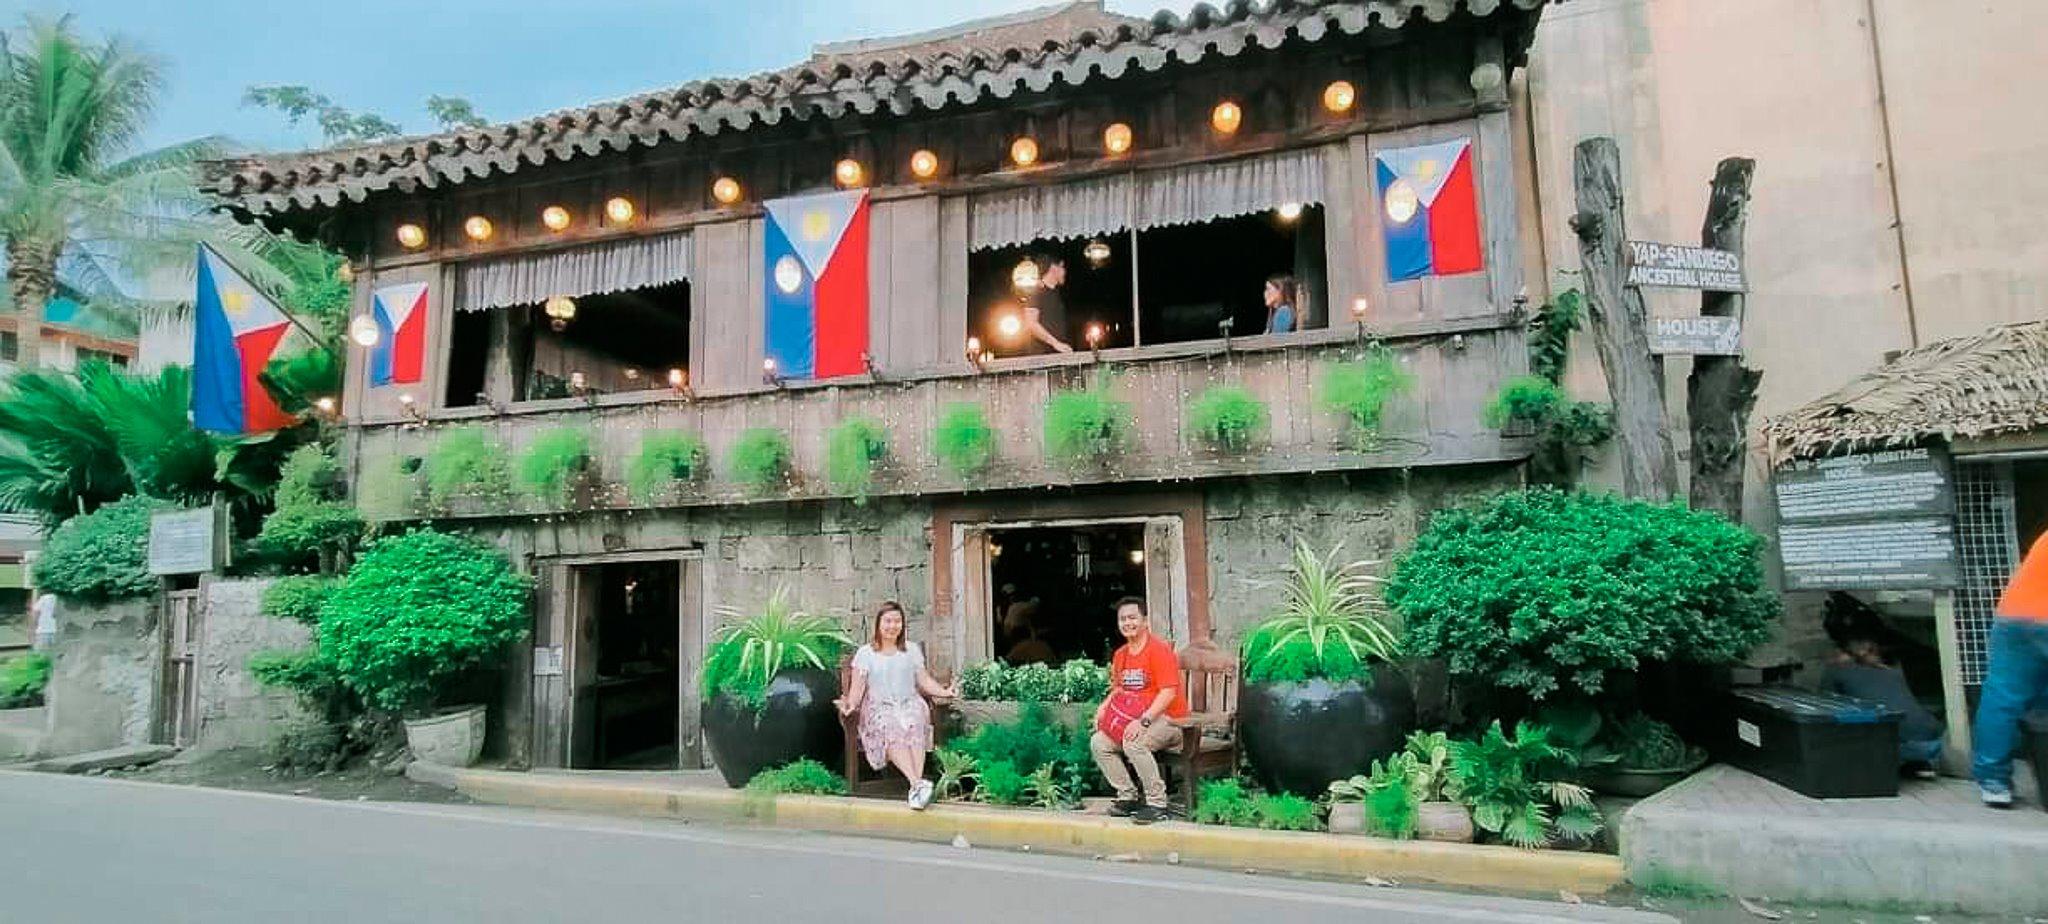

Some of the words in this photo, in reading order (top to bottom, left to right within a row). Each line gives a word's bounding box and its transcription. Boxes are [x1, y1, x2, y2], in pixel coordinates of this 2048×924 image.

[1628, 266, 1698, 286] ANCESTRAL
[1700, 270, 1741, 288] HOUSE
[1657, 319, 1721, 336] HOUSE
